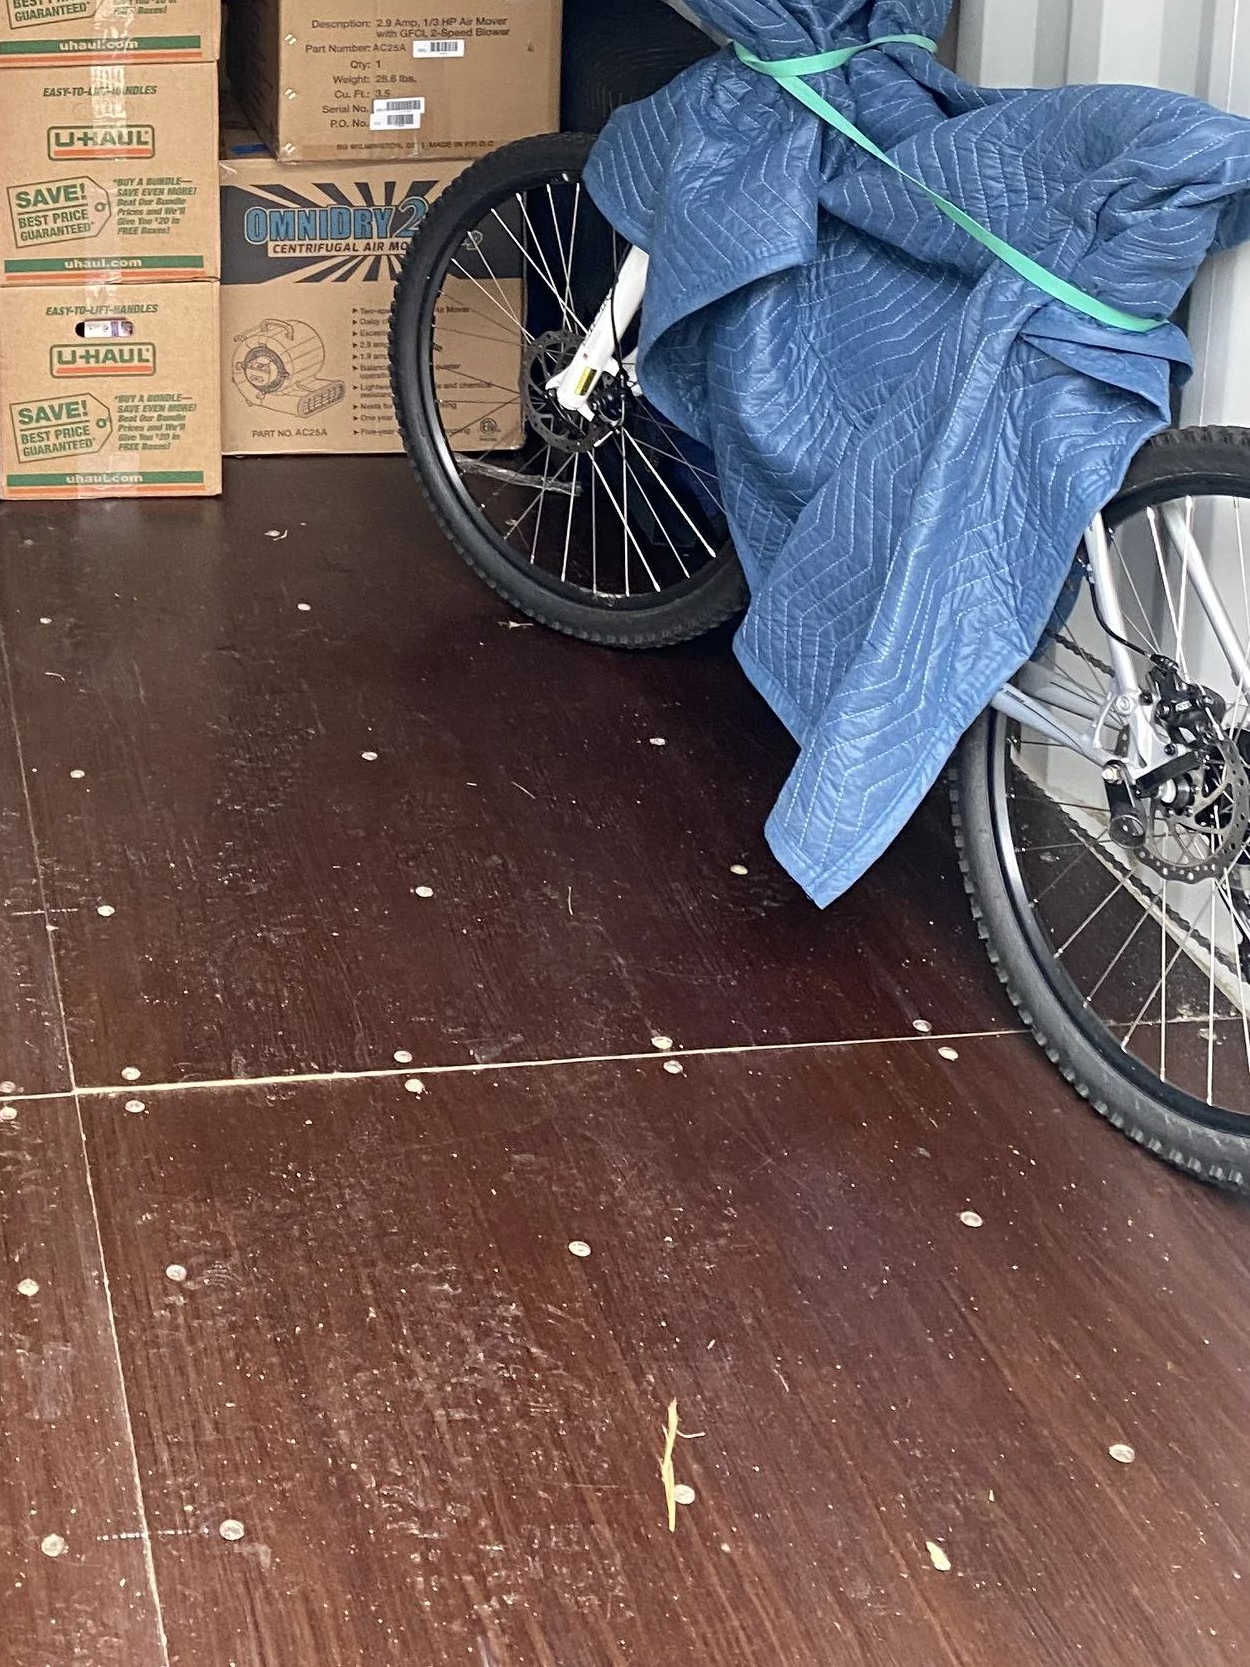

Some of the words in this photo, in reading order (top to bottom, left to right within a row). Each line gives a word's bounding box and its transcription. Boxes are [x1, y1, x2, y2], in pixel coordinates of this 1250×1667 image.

[312, 20, 371, 30] Description:
[377, 19, 392, 27] 2.9
[394, 19, 420, 28] Amp,
[424, 18, 439, 26] 1/3
[442, 18, 457, 26] HP
[476, 18, 508, 26] Mover
[377, 29, 397, 38] with
[431, 29, 473, 38] 2-Speed
[476, 28, 510, 36] Blower
[305, 45, 326, 53] Part
[329, 44, 370, 53] Number:
[373, 44, 406, 52] AC25A
[350, 60, 370, 69] Qty:
[376, 60, 381, 68] 1
[333, 76, 370, 84] Weight:
[322, 105, 349, 113] Serial
[331, 120, 349, 128] P.O.
[353, 119, 369, 127] No.
[55, 130, 149, 147] U-HAUL
[16, 183, 86, 209] SAVE!
[18, 216, 49, 229] BEST
[53, 209, 88, 224] PRICE
[273, 243, 358, 254] CENTRIFUGAL
[362, 242, 385, 252] AIR
[64, 258, 142, 269] uhaul.com
[57, 348, 150, 365] U-HAUL
[18, 400, 88, 425] SAVE!
[21, 431, 51, 445] BEST
[55, 426, 90, 440] PRICE
[252, 429, 274, 438] PART
[276, 429, 293, 437] NO.
